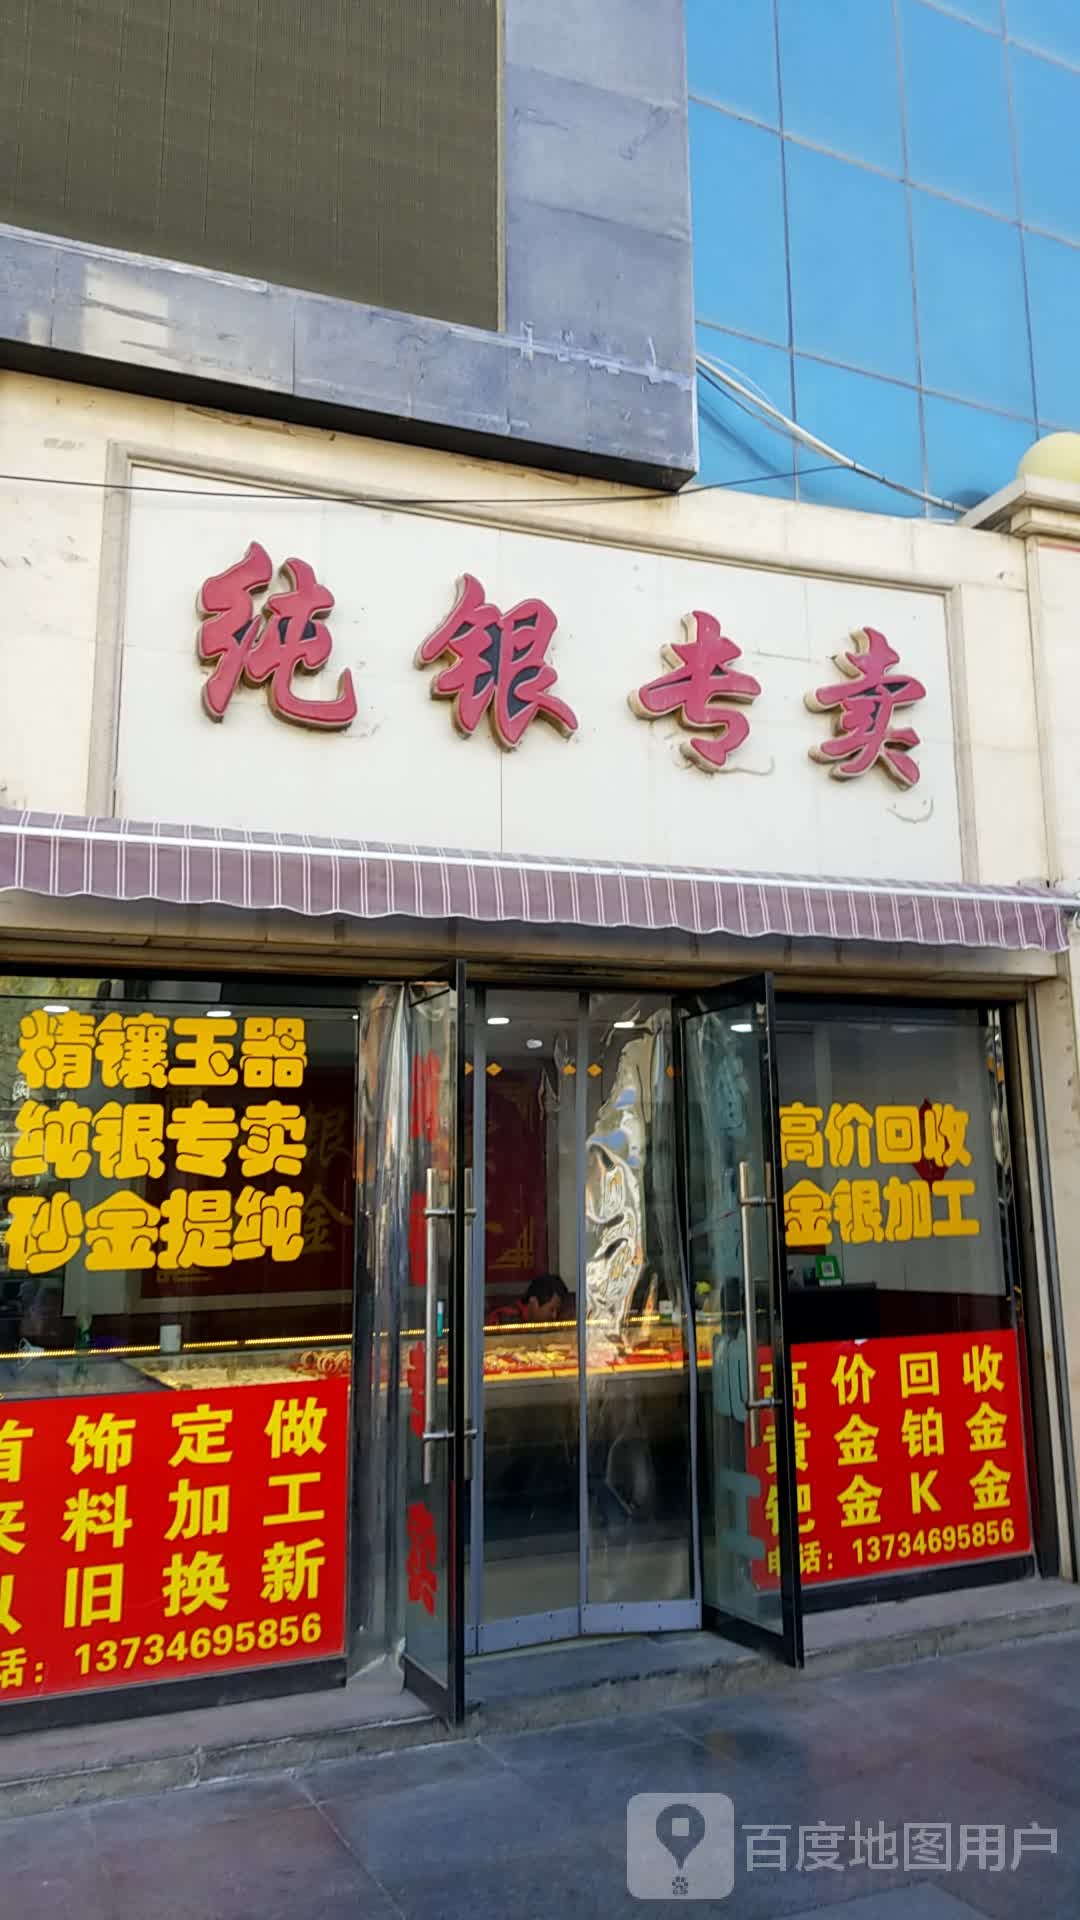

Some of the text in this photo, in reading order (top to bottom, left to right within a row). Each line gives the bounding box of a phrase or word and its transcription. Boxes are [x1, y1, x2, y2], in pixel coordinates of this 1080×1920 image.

[197, 541, 927, 789] 纯银专卖
[17, 1009, 308, 1089] 精镶玉器
[10, 1099, 307, 1179] 纯银专卖
[779, 1102, 972, 1168] 高价回收
[5, 1186, 304, 1274] 砂金提纯
[783, 1175, 981, 1247] 金银加工
[852, 1518, 1015, 1564] 13734695856
[75, 1612, 322, 1675] 13734695856
